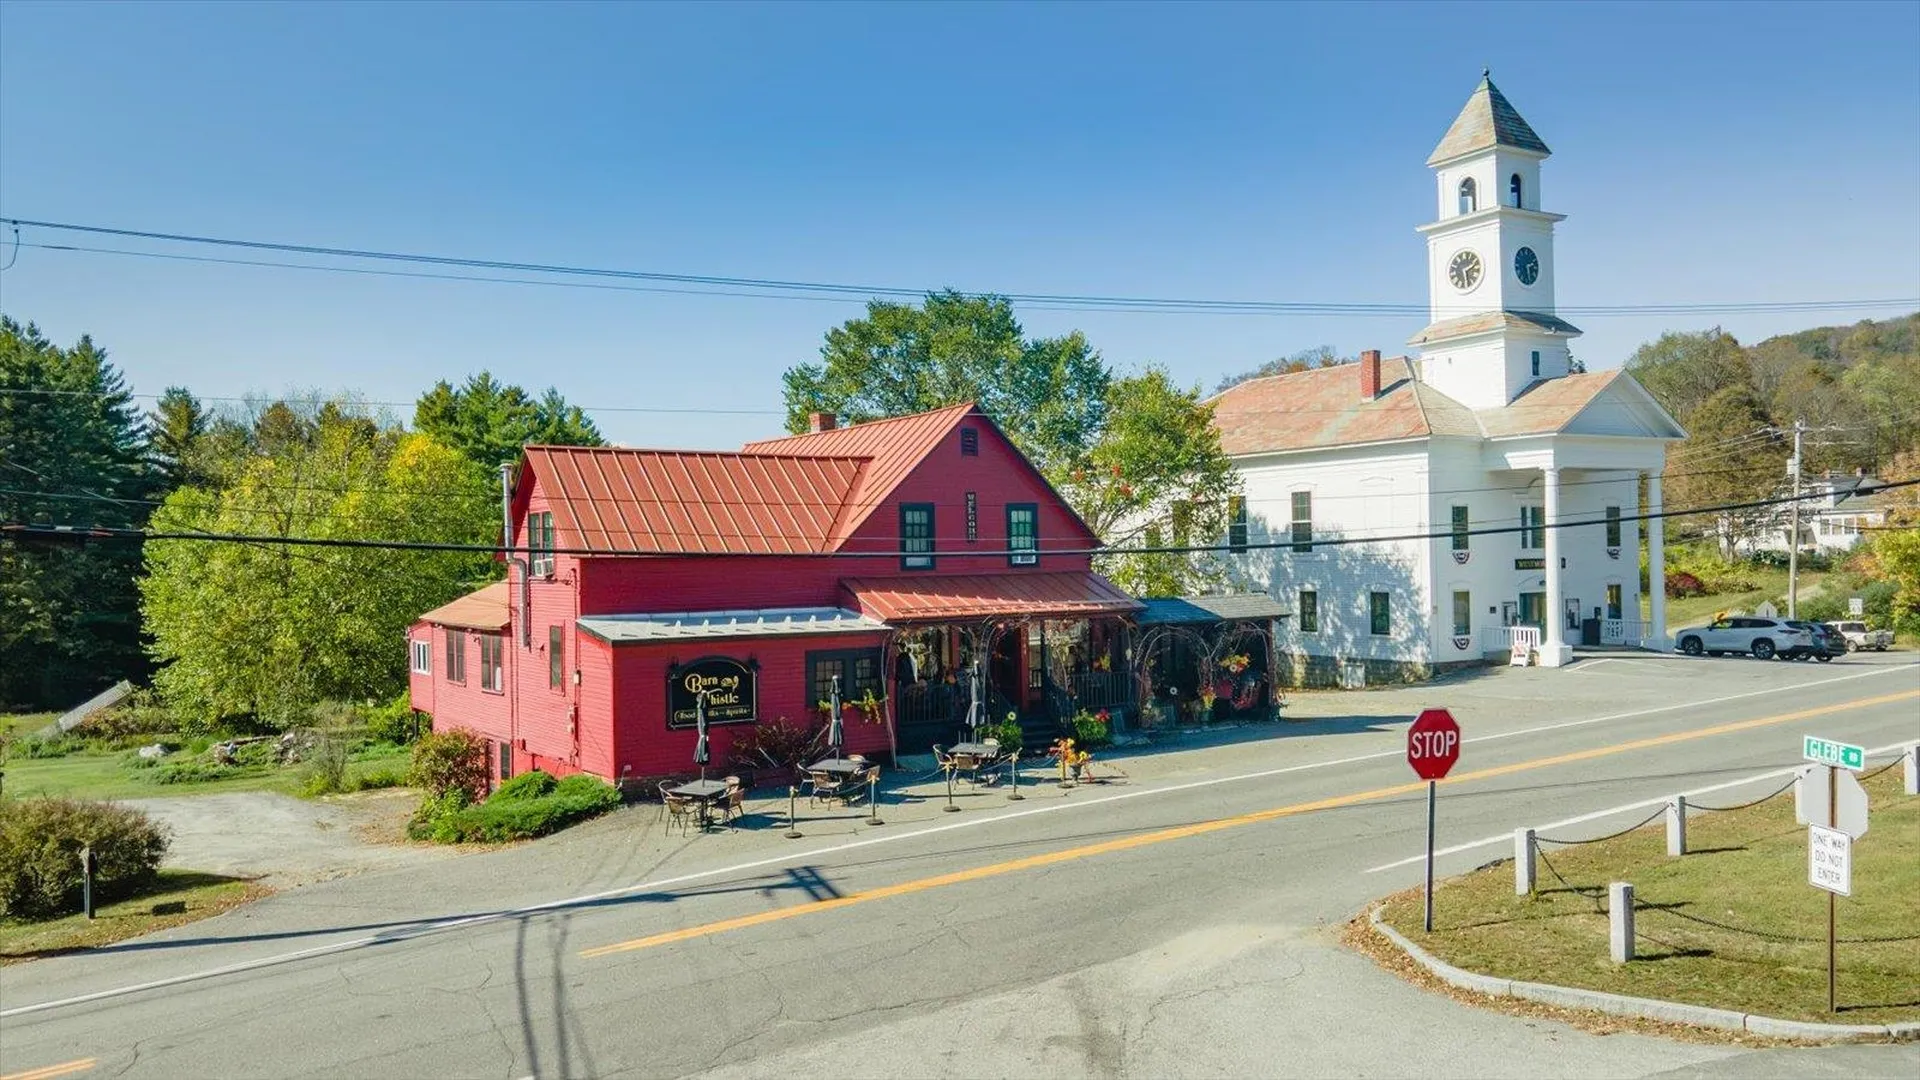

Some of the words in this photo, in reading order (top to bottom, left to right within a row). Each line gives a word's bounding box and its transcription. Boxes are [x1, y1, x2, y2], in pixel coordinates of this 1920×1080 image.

[685, 673, 718, 693] Barn
[1410, 730, 1457, 759] STOP
[1810, 740, 1846, 764] GLEBE
[1813, 832, 1828, 847] ONE
[1831, 838, 1846, 851] WAY
[1814, 850, 1826, 862] DO
[1828, 853, 1843, 868] NOT
[1818, 867, 1841, 883] ENTER
